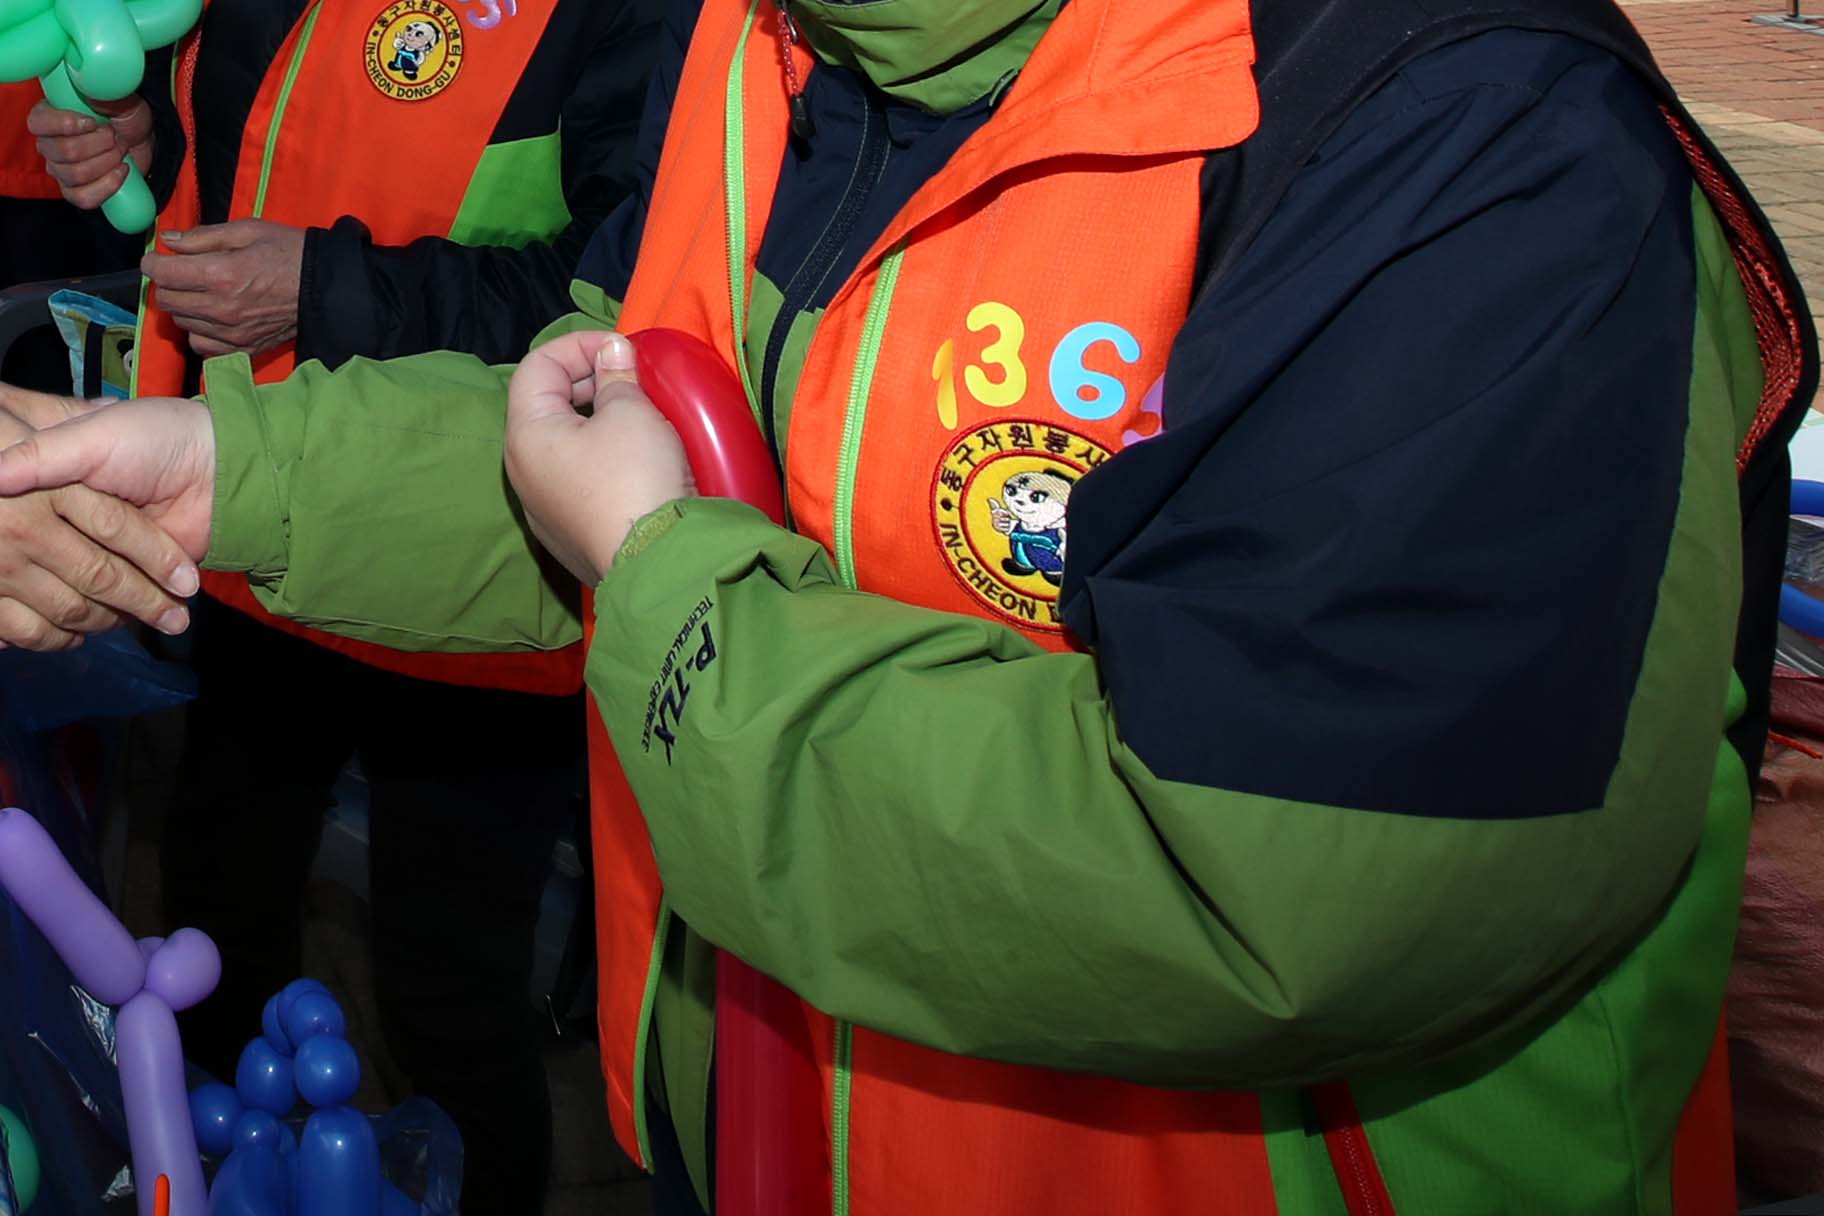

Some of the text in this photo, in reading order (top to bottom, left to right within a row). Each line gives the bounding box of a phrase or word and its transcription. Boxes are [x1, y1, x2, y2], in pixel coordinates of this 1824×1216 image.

[366, 42, 450, 98] IN-CHEON DONG-GU
[940, 422, 1112, 492] 동구자원봉사
[940, 523, 1037, 621] IN-CHEON
